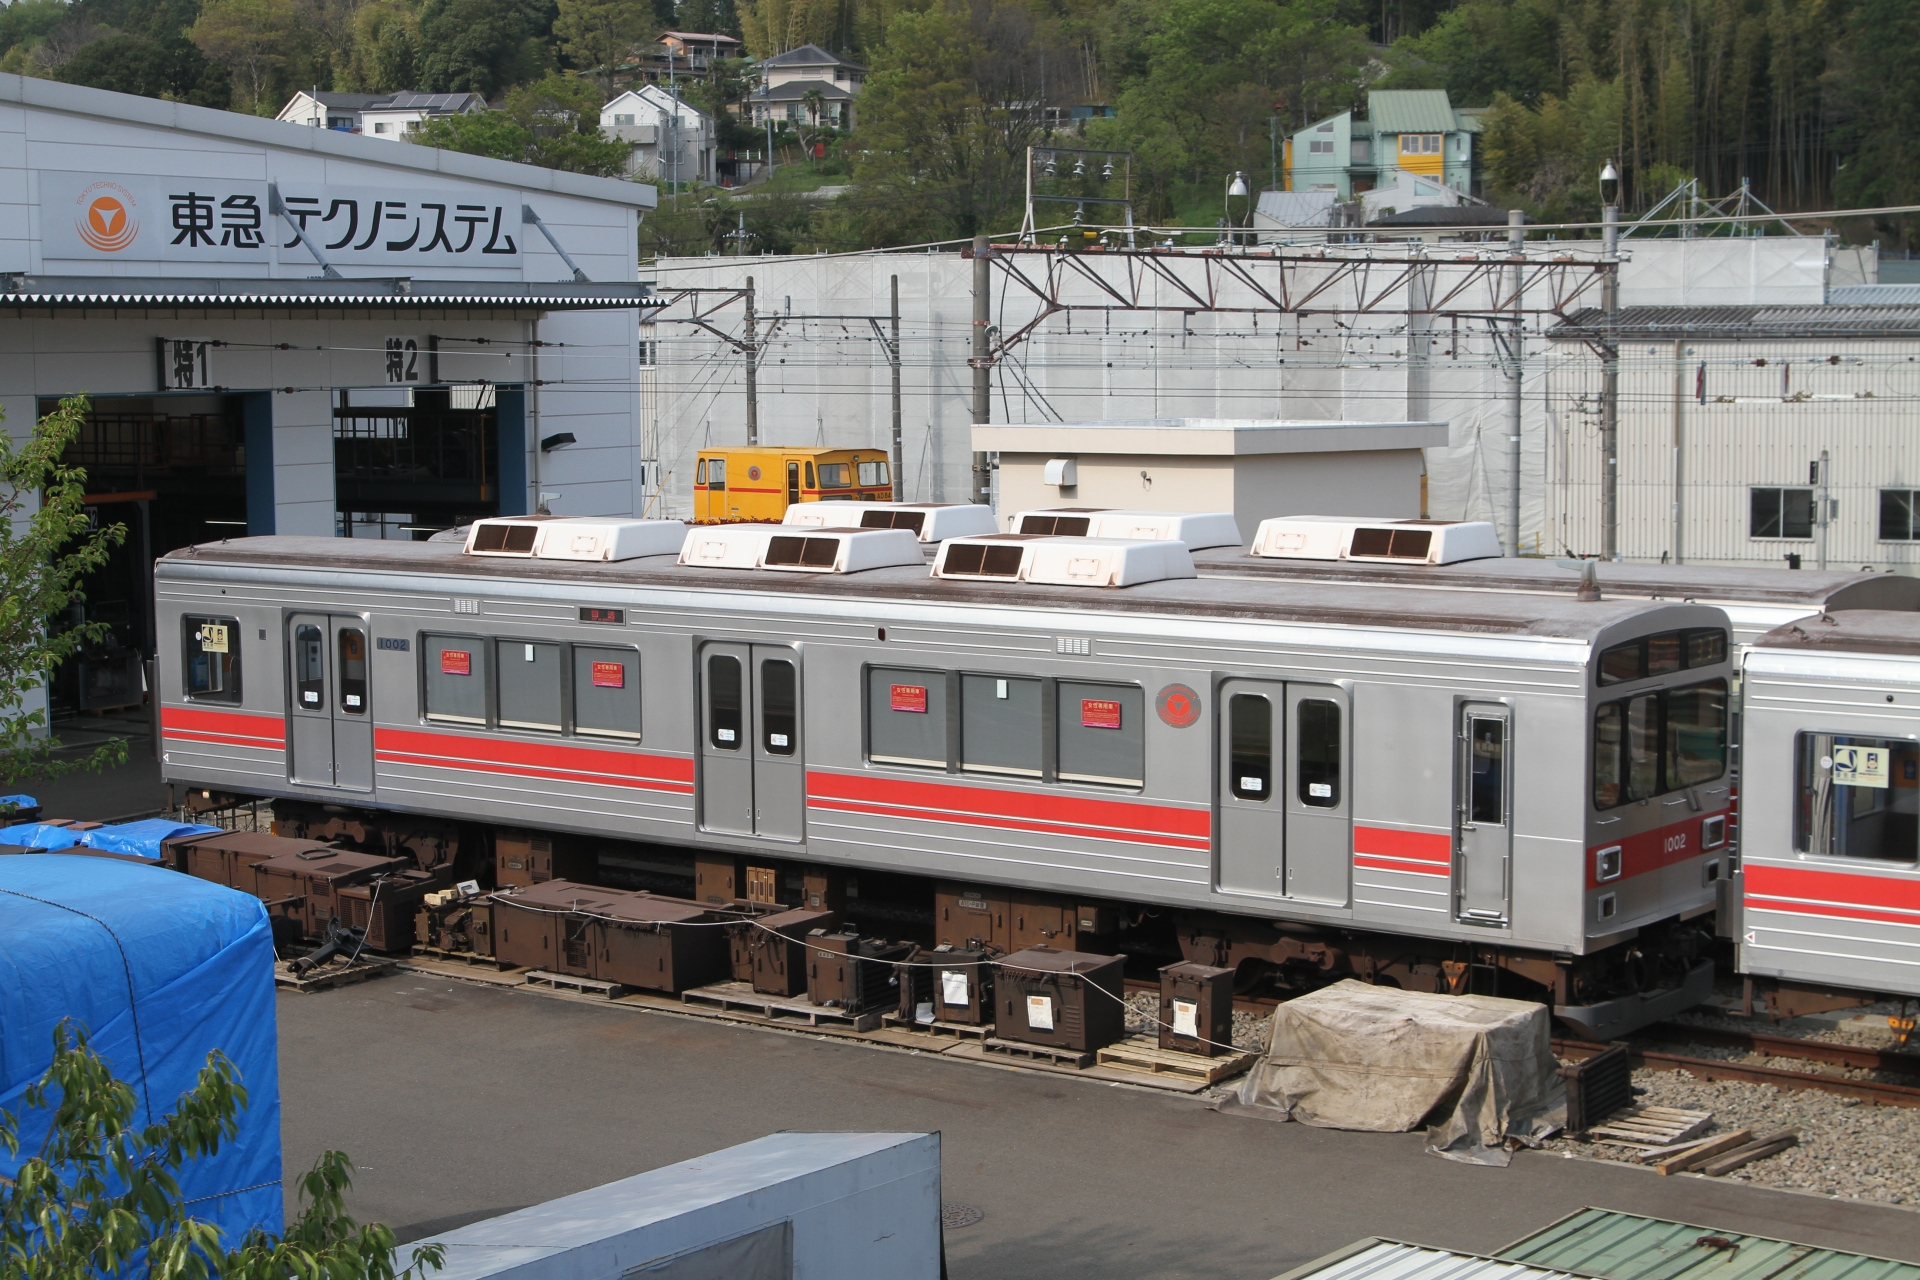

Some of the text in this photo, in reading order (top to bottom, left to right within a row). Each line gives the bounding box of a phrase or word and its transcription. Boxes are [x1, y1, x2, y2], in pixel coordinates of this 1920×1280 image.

[76, 181, 137, 207] TOKYU TECHNO SYSTEM
[169, 192, 517, 254] 東急テクノシステム
[386, 338, 418, 382] 特2
[380, 638, 406, 650] 1002
[1664, 833, 1686, 853] 1002
